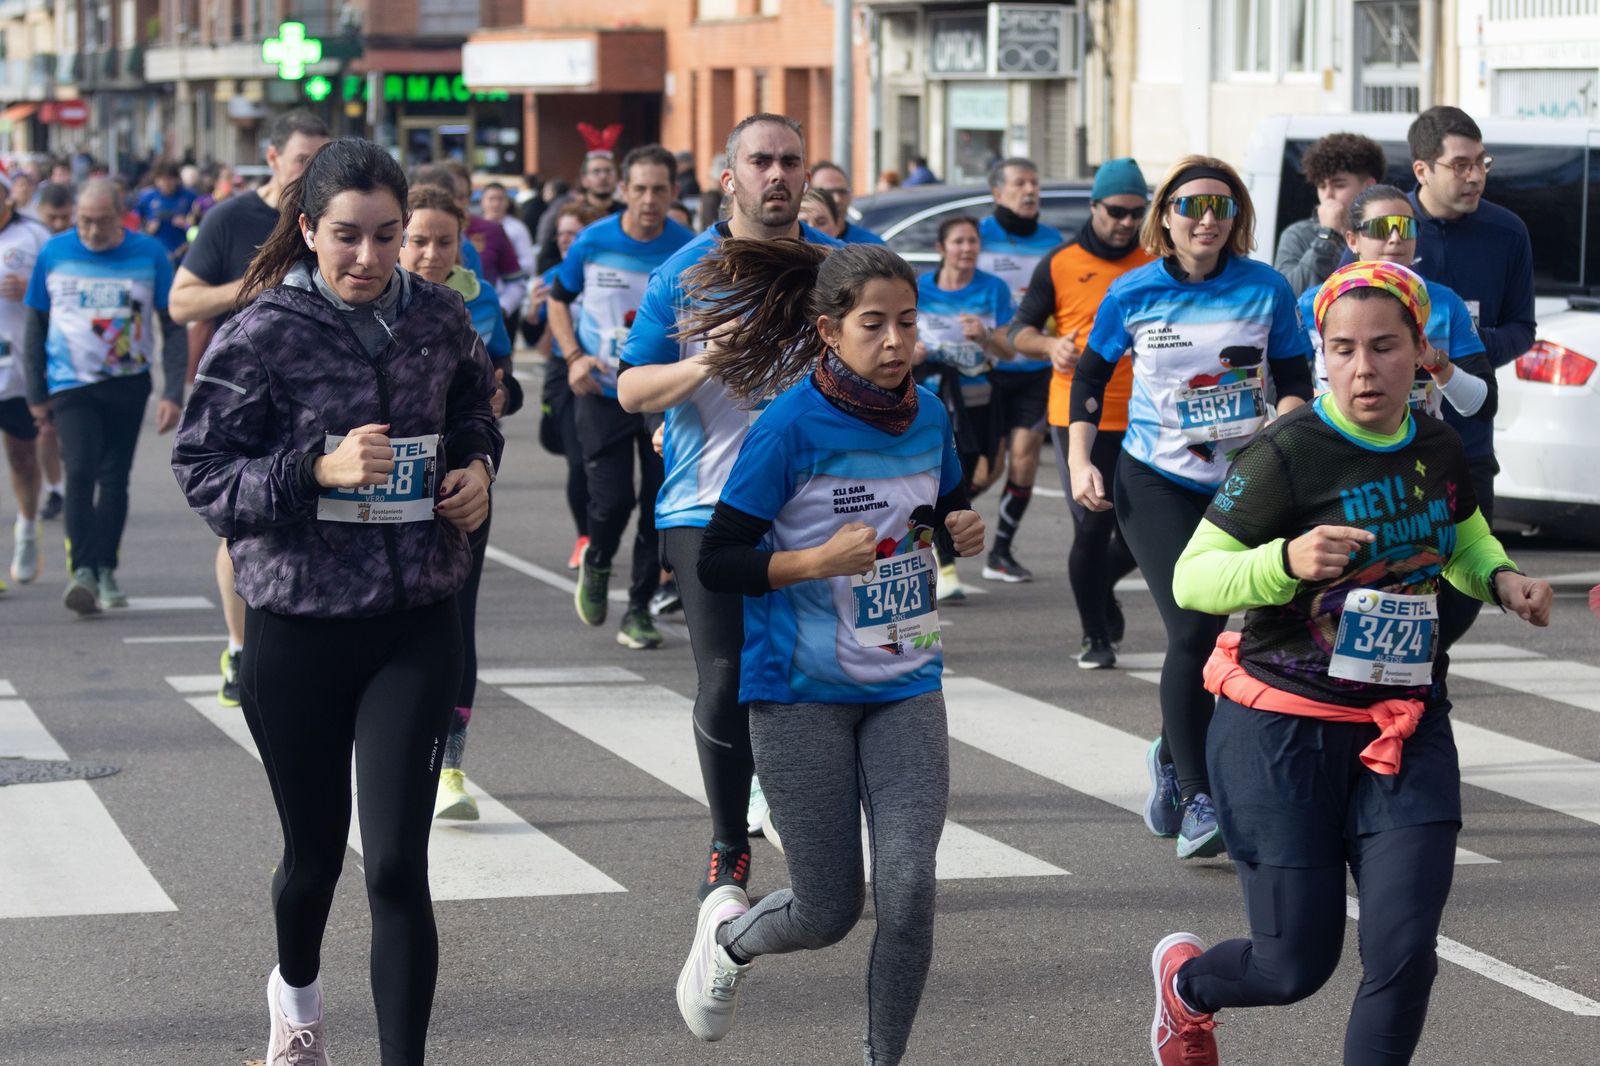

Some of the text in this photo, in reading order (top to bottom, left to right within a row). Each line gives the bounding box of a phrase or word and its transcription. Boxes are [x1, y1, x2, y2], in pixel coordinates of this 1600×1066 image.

[1187, 392, 1241, 423] 5937
[337, 461, 414, 495] 48
[832, 486, 865, 496] XLI SAN
[833, 493, 875, 506] SILVESTRE
[833, 500, 889, 514] SALMANTINA
[1339, 474, 1408, 522] HEY!
[879, 555, 926, 578] SETEL
[866, 575, 922, 620] 3423
[1380, 599, 1431, 616] SETEL
[1354, 615, 1423, 657] 3424
